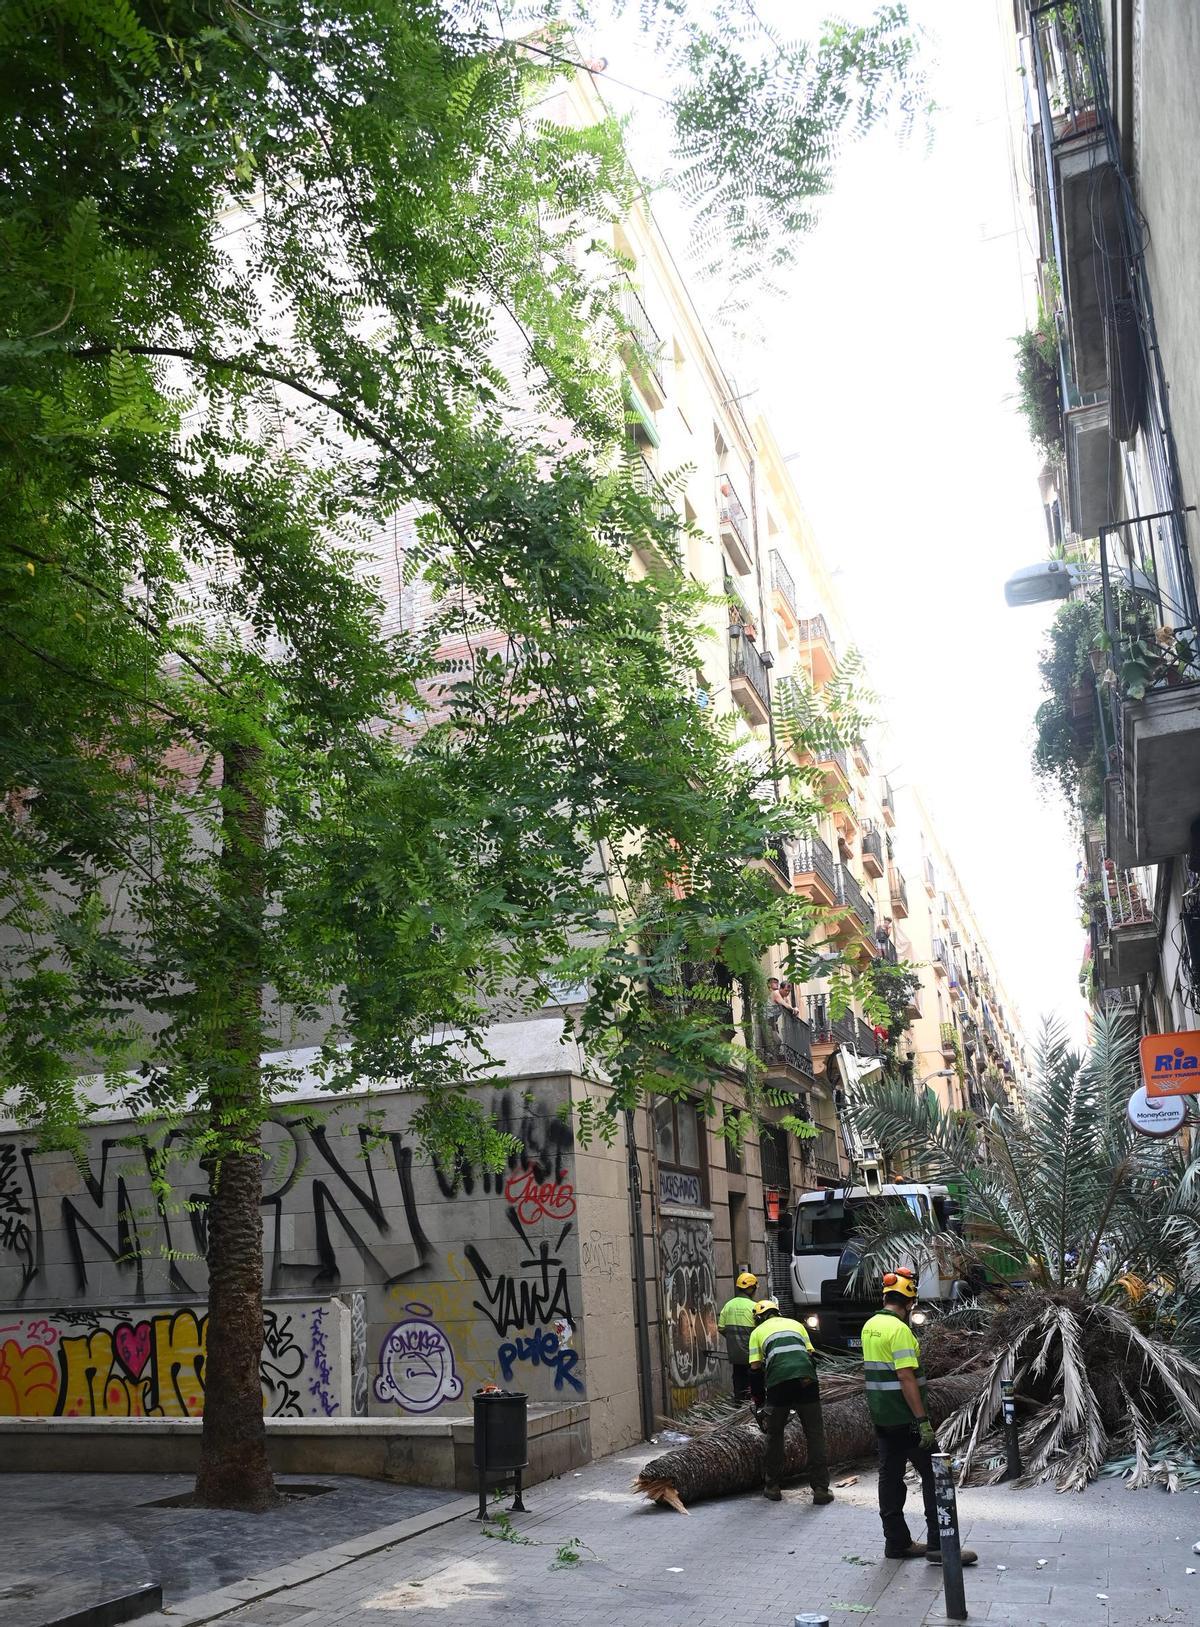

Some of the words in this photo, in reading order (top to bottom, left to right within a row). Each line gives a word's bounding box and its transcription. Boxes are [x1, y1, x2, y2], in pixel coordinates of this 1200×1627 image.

[1155, 1048, 1198, 1072] Ria
[1136, 1111, 1180, 1120] MoneyGram
[27, 1320, 58, 1346] 23
